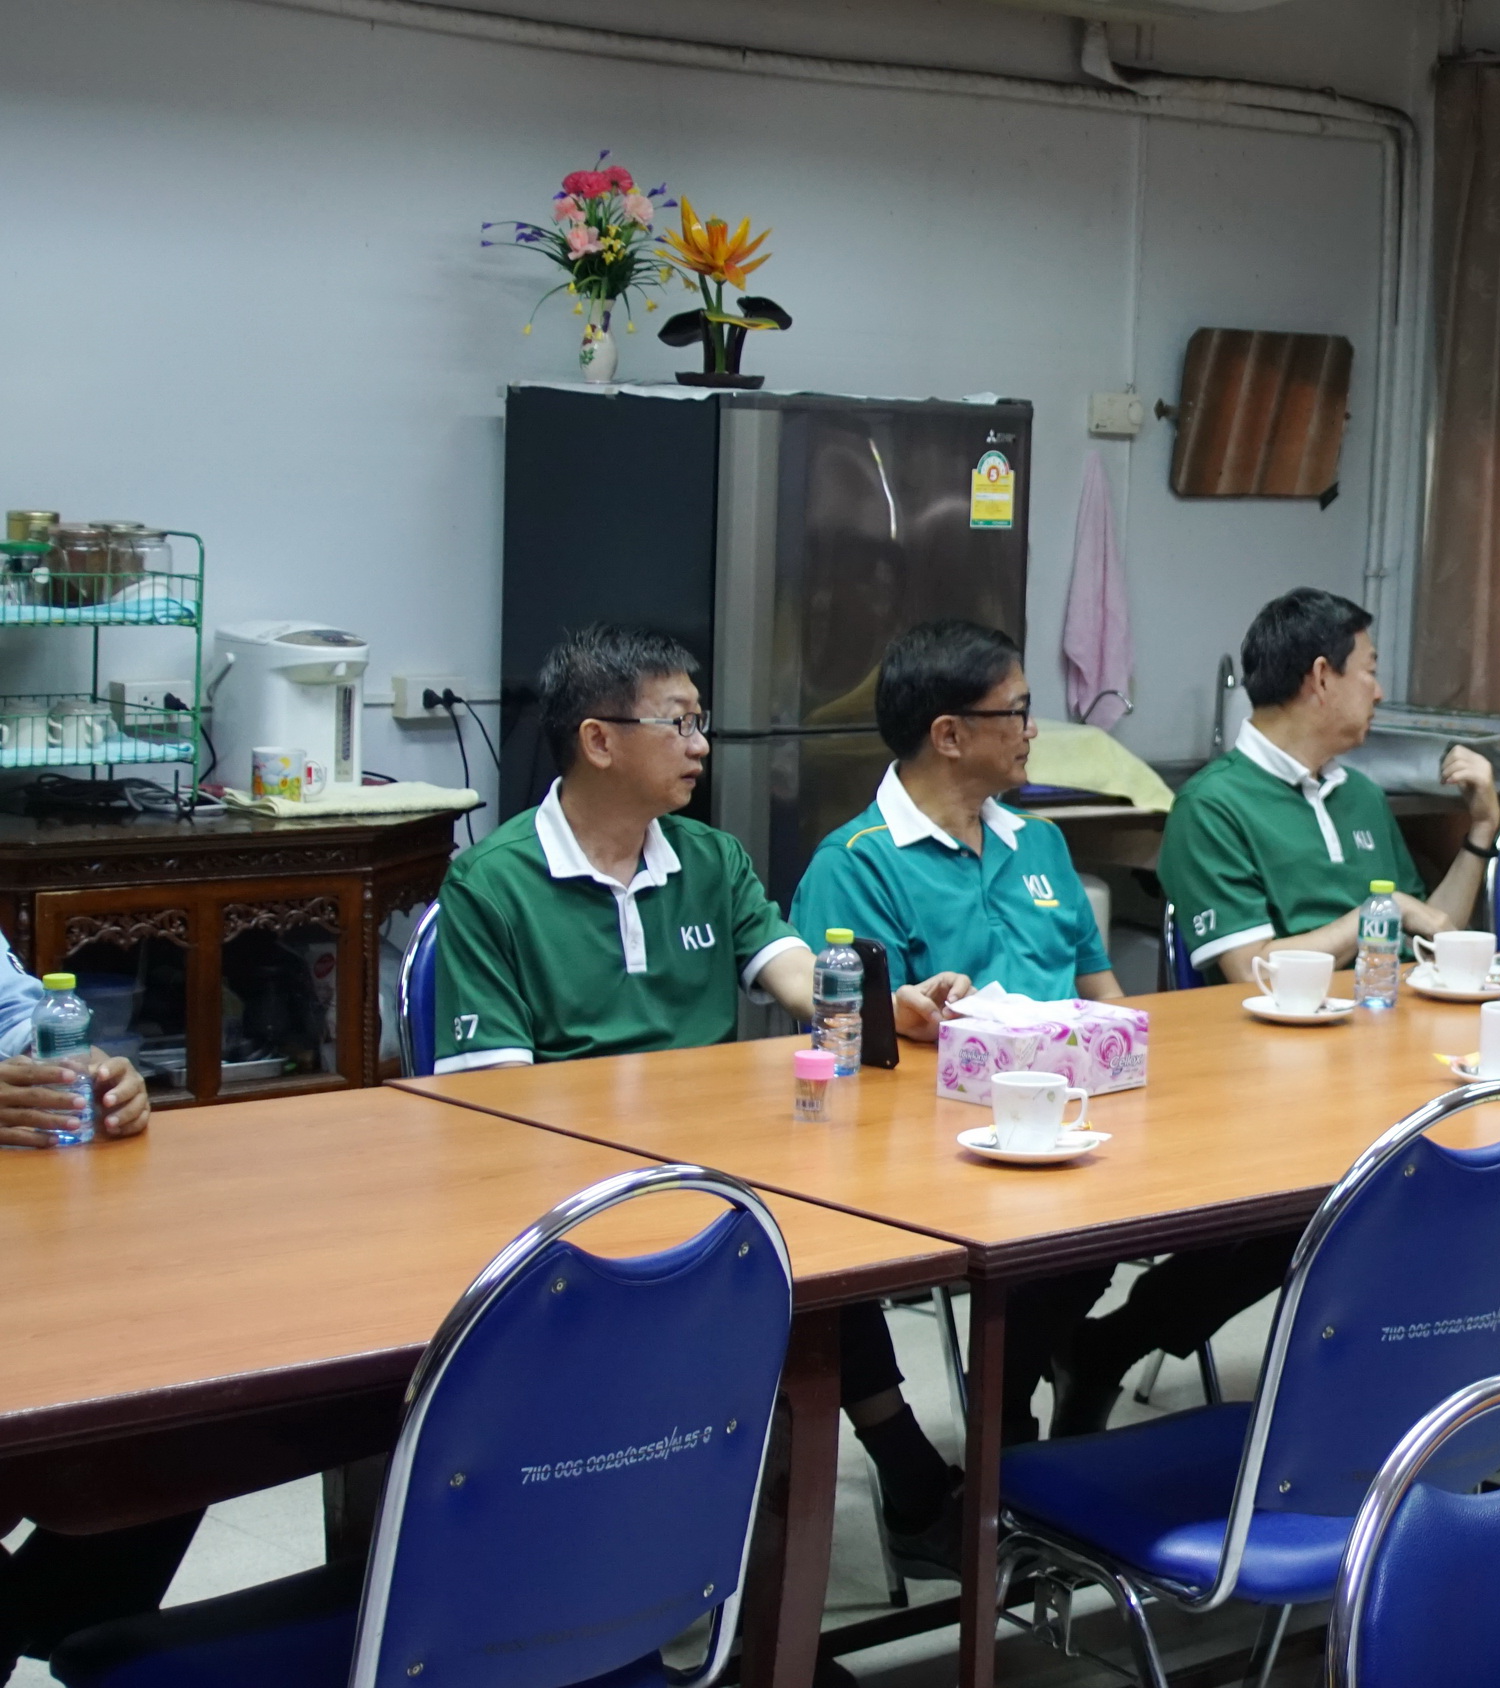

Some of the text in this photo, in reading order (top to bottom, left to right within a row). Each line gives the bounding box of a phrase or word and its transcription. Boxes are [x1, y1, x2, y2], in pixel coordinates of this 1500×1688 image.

[1352, 830, 1375, 851] KU
[1022, 874, 1053, 900] KU
[680, 923, 715, 950] KU
[1363, 919, 1388, 937] KU
[521, 1464, 551, 1484] 7110
[554, 1460, 583, 1478] 006
